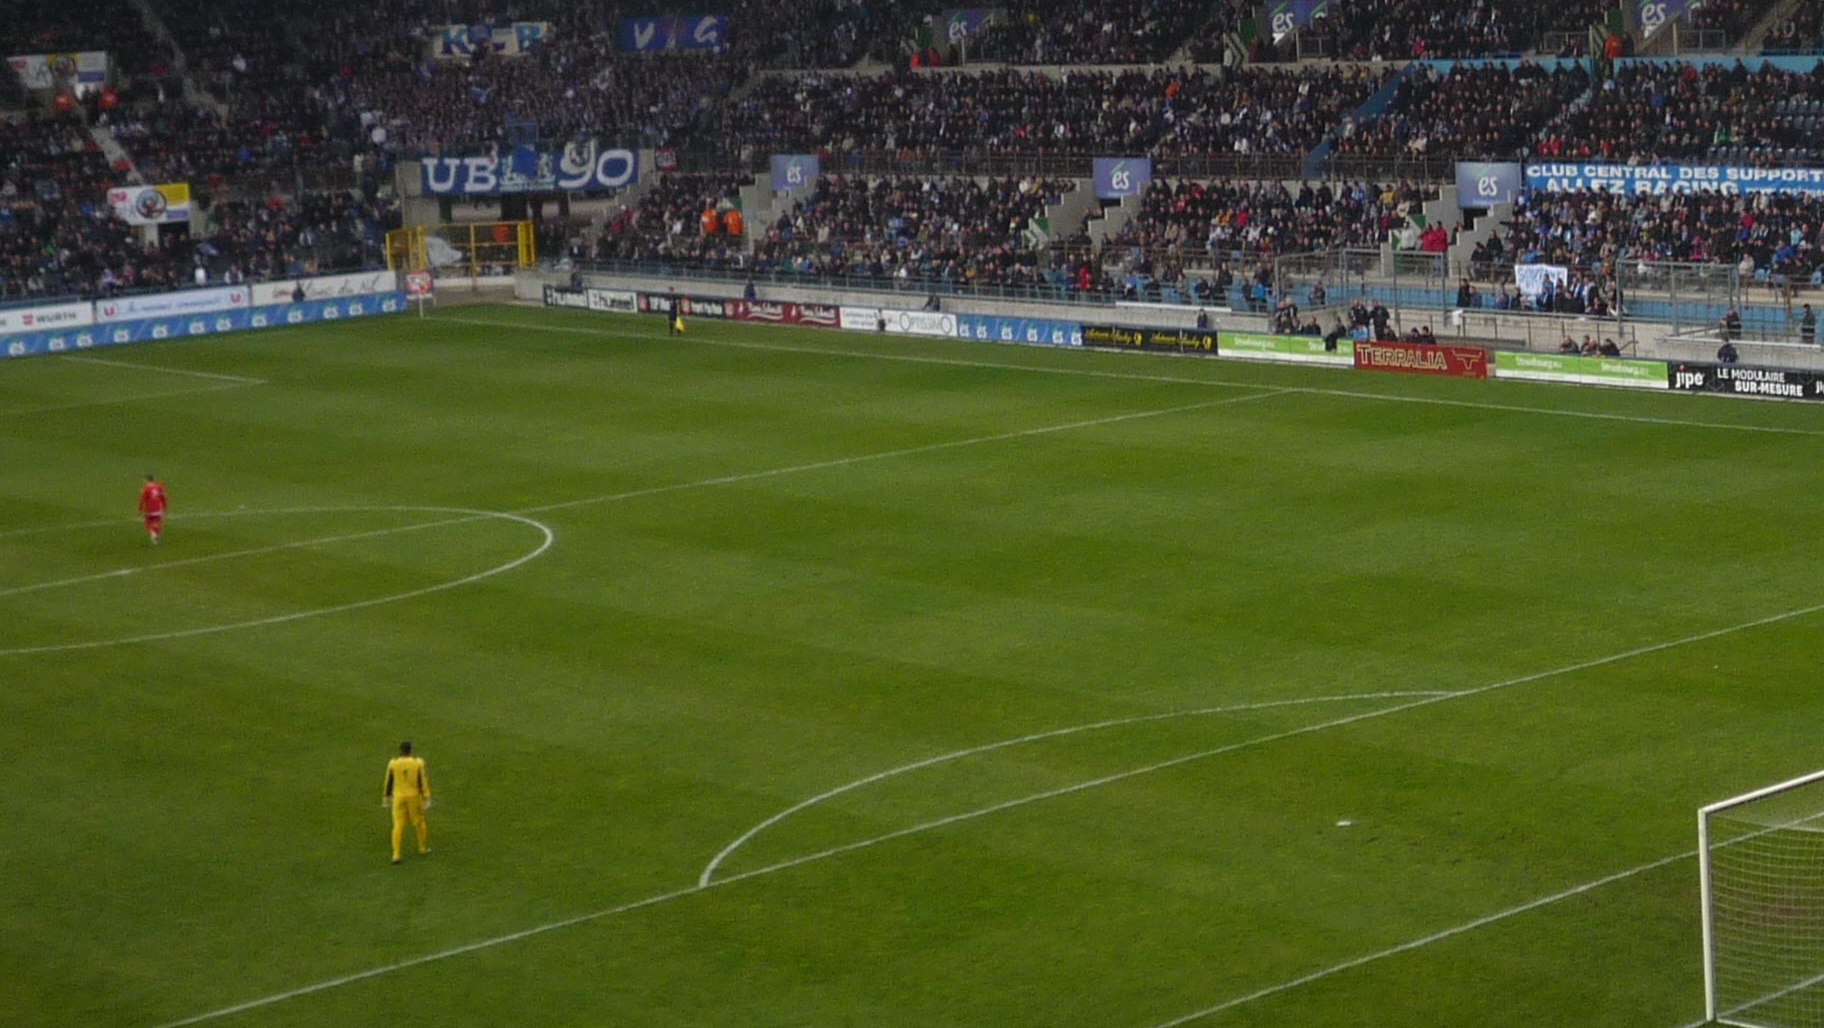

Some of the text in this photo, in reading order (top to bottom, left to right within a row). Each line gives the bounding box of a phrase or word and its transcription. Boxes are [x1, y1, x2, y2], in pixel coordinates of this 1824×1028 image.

[421, 155, 498, 193] UB
[1526, 164, 1579, 178] CLUB
[1584, 165, 1662, 180] CENTRAL
[1669, 166, 1720, 181] DES
[1546, 178, 1625, 195] ALLEZ
[1634, 179, 1739, 196] RACING
[1356, 343, 1448, 370] TERRALIA
[1717, 367, 1786, 384] LE MODULAIRE
[1735, 380, 1804, 397] SUR-MESURE
